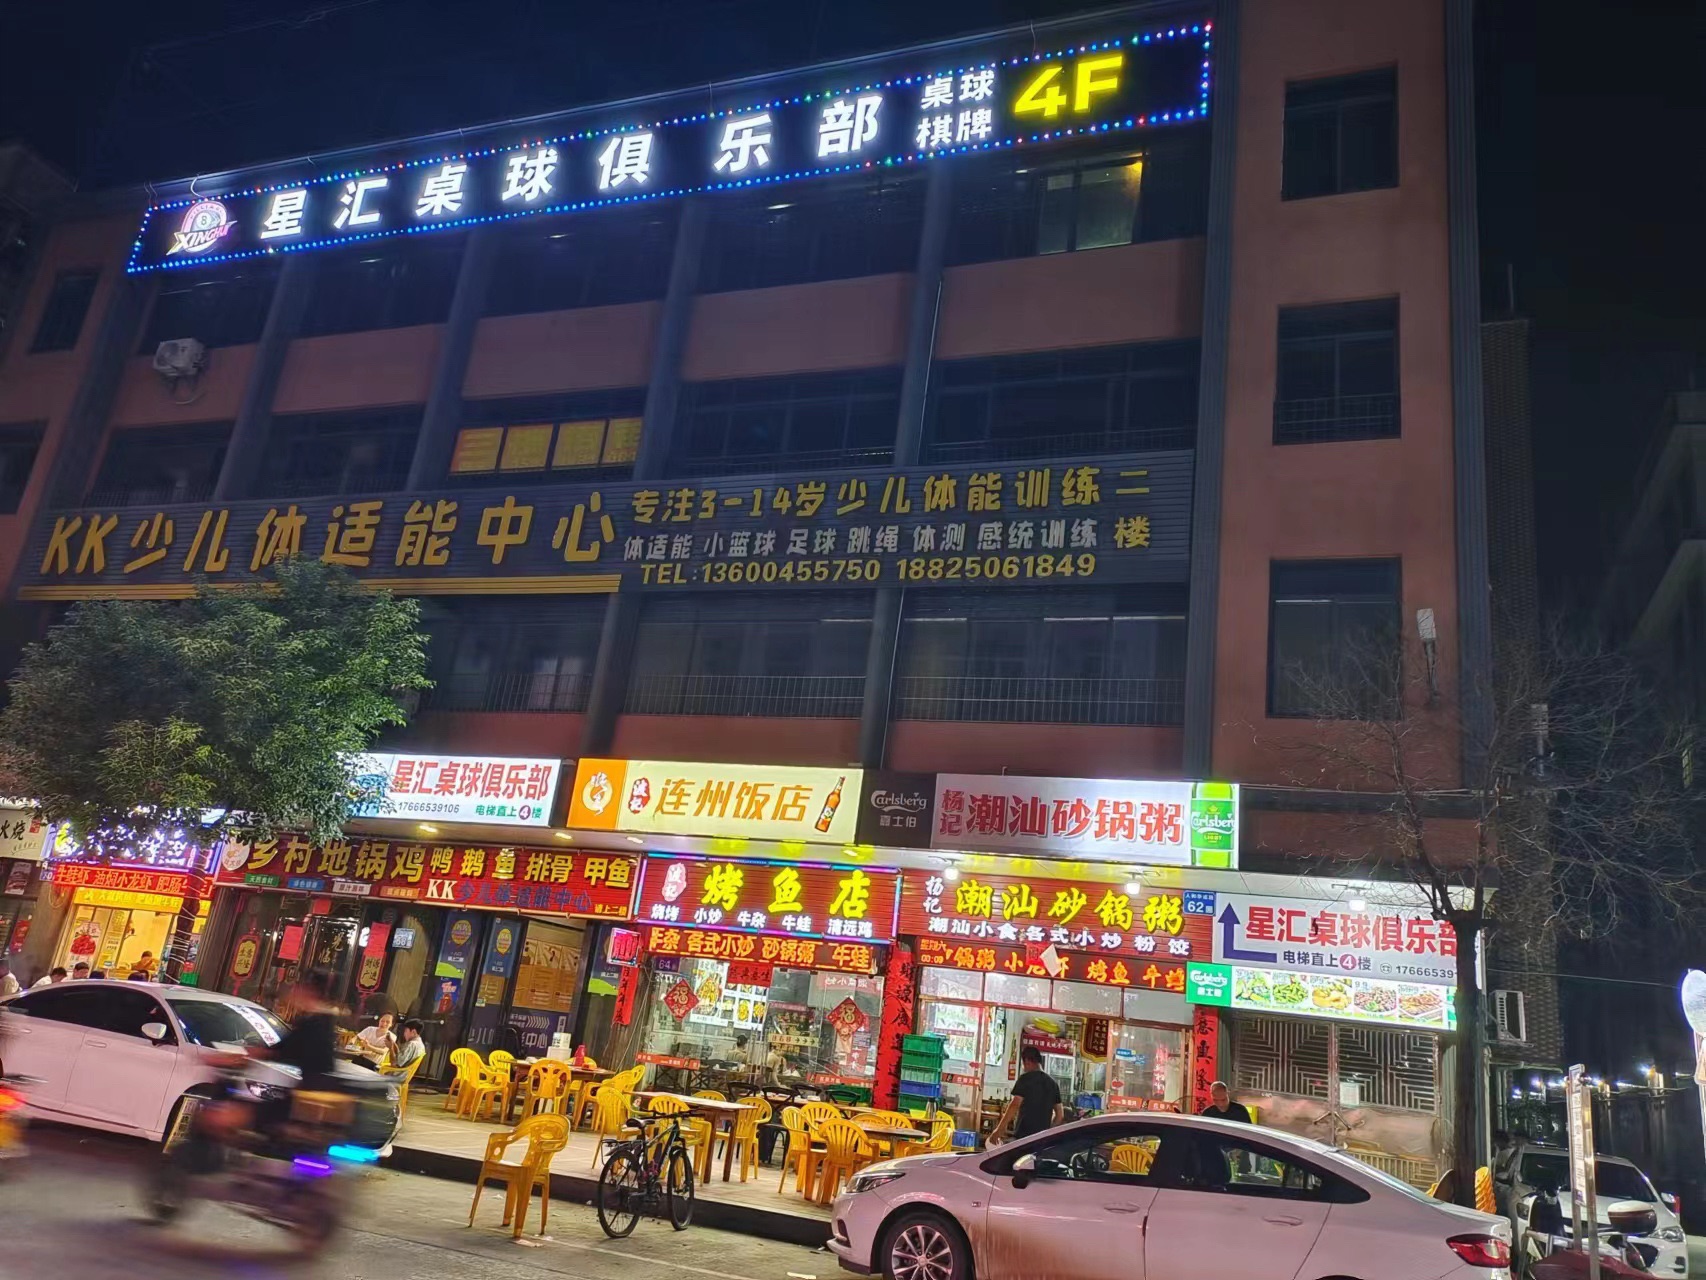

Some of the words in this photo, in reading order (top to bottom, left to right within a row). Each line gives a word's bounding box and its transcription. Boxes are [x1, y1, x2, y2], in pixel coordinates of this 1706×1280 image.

[922, 70, 996, 111] 桌球
[1014, 53, 1124, 118] 4F
[915, 108, 994, 150] 棋牌
[260, 95, 884, 240] 星汇桌球俱乐部
[40, 491, 615, 576] KK少儿体适能中心
[623, 532, 691, 562] 体适能
[703, 529, 777, 559] 小篮球
[785, 527, 837, 557] 足球
[846, 524, 901, 555] 跳绳
[911, 521, 967, 553] 体测
[976, 518, 1098, 552] 感统训练
[895, 552, 1097, 581] 18825061849
[389, 759, 553, 802] 星汇桌球俱乐部
[654, 777, 814, 823] 连州饭店
[871, 790, 928, 812] Carlsberg
[397, 802, 461, 814] 17666539106
[939, 788, 965, 837] 杨记
[966, 793, 1184, 845] 潮汕砂锅粥
[247, 834, 426, 883] 乡村地锅鸡
[429, 846, 452, 871] 鸭
[459, 848, 485, 876] 鹅
[491, 847, 516, 880] 鱼
[524, 853, 573, 883] 排骨
[583, 857, 631, 889] 甲鱼
[700, 862, 872, 919] 烤鱼店
[956, 879, 1185, 936] 潮汕砂锅粥
[693, 909, 723, 925] 小炒
[686, 931, 755, 957] 各式小炒
[945, 945, 996, 971] 锅粥
[1086, 958, 1131, 985] 烤鱼
[1283, 949, 1372, 972] 电梯直上4楼
[1395, 965, 1458, 980] 17666539
